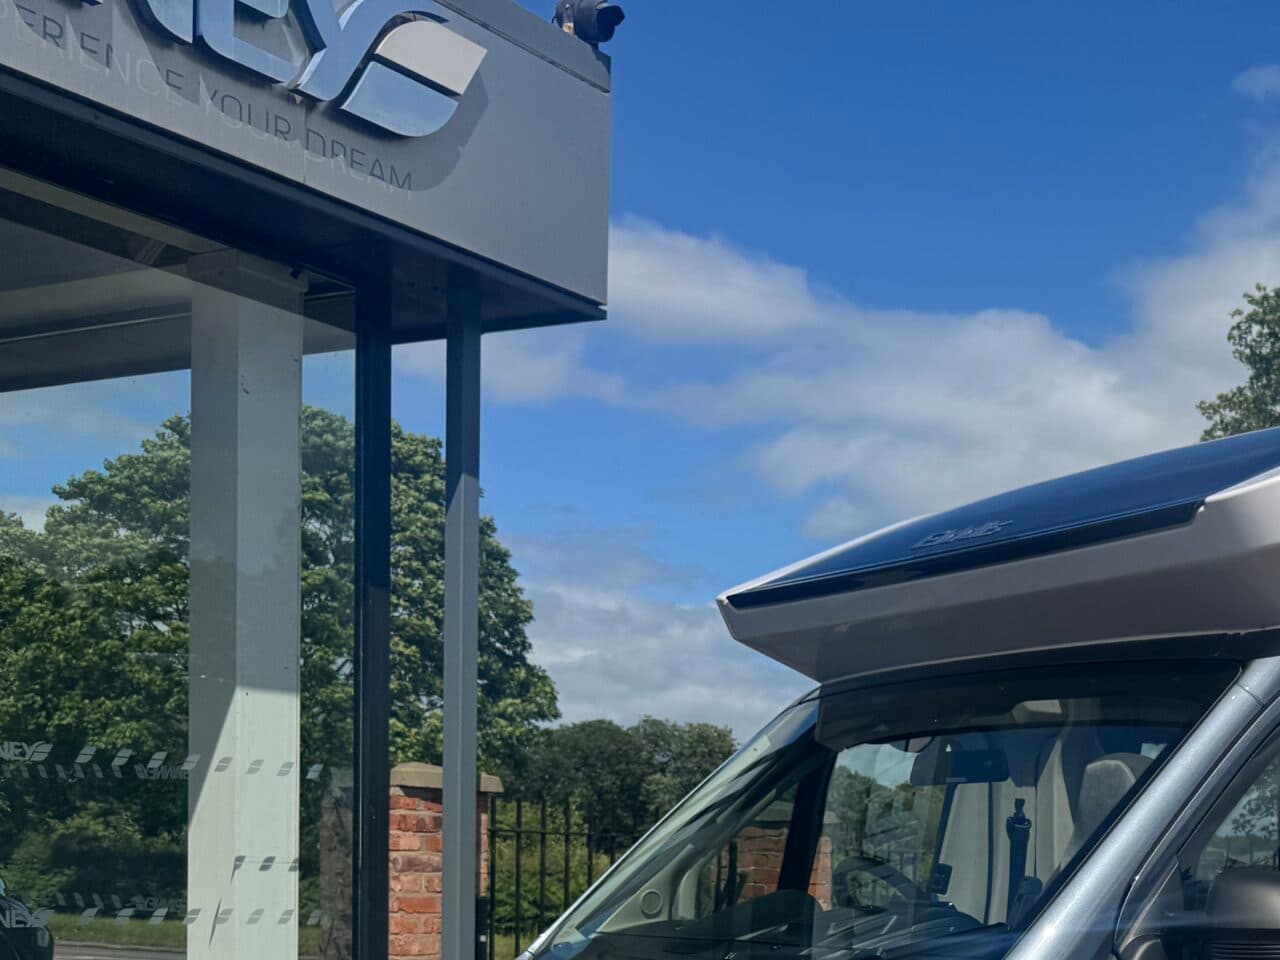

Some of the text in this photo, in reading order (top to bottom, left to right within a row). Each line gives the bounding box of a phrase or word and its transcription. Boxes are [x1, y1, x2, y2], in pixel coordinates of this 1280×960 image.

[0, 0, 413, 200] ERIENCE YOUR DREAM
